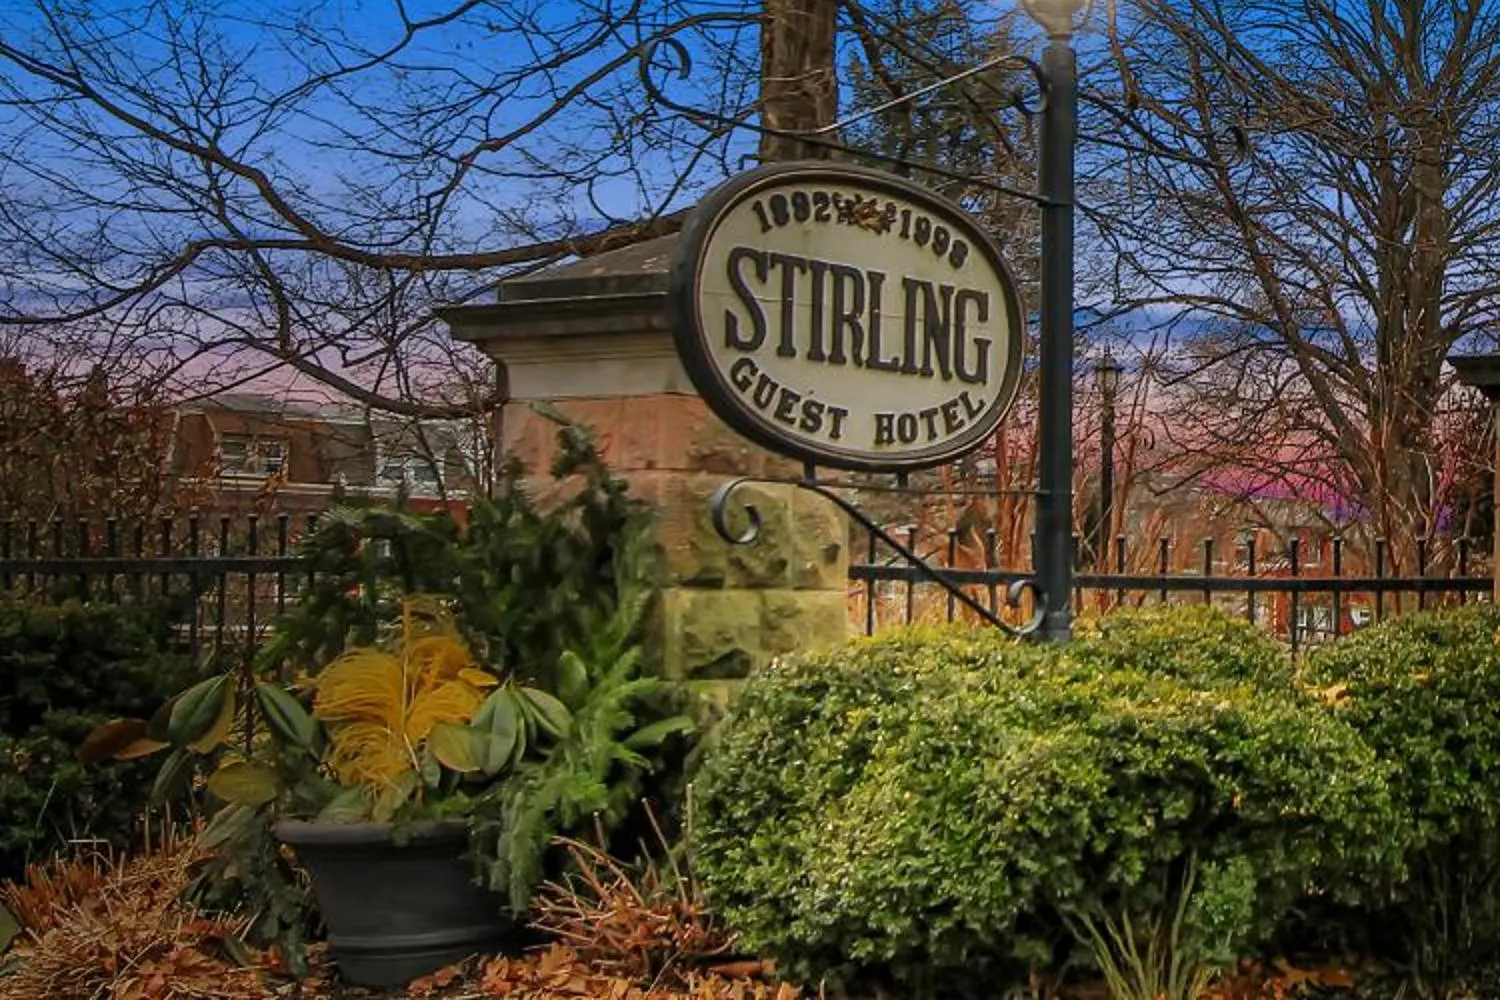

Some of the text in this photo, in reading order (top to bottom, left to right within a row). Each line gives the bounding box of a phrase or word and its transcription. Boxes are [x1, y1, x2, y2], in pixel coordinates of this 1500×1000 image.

[724, 246, 993, 386] STIRLING
[730, 357, 986, 446] GUEST HOTEL
